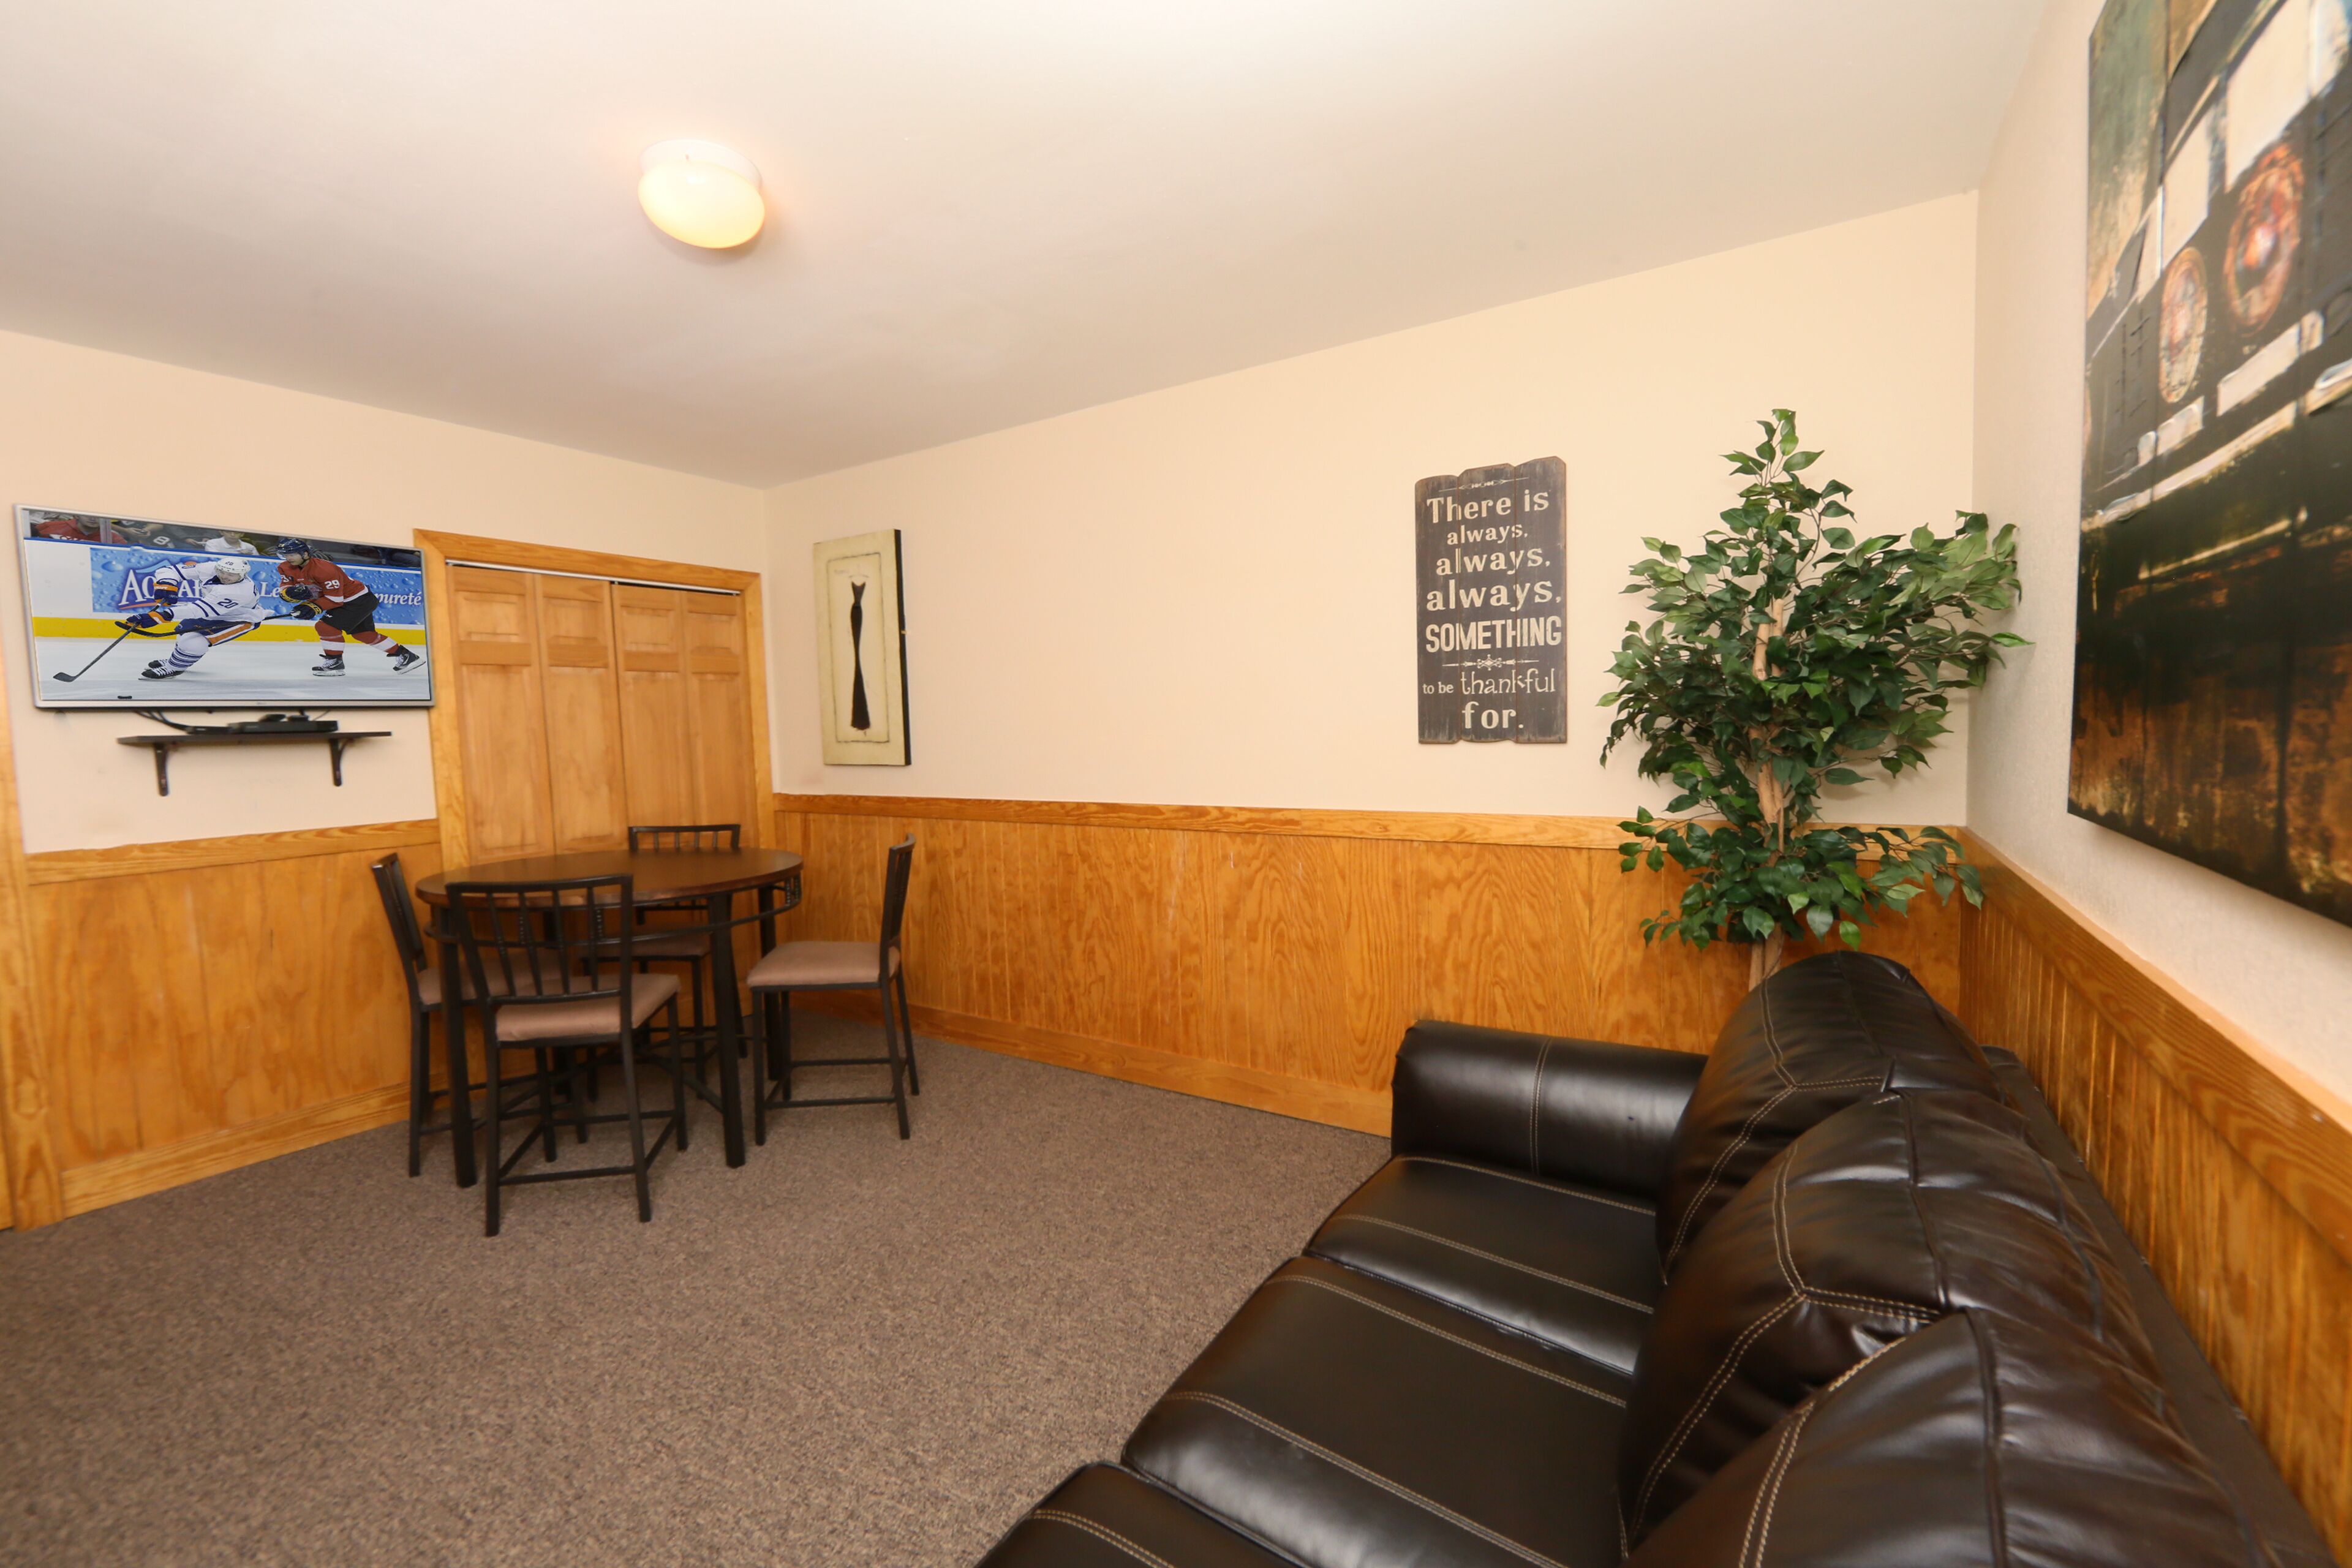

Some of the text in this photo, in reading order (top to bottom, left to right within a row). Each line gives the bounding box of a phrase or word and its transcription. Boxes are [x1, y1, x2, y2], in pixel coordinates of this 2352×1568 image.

[1427, 489, 1549, 523] There is
[1447, 524, 1528, 545] always,
[1436, 548, 1550, 575] always,
[325, 579, 340, 589] 29
[1427, 579, 1561, 612] always,
[217, 598, 238, 609] 20
[1425, 616, 1561, 652] SOMETHING
[1422, 668, 1555, 695] to be thankful
[1461, 701, 1524, 729] for.
